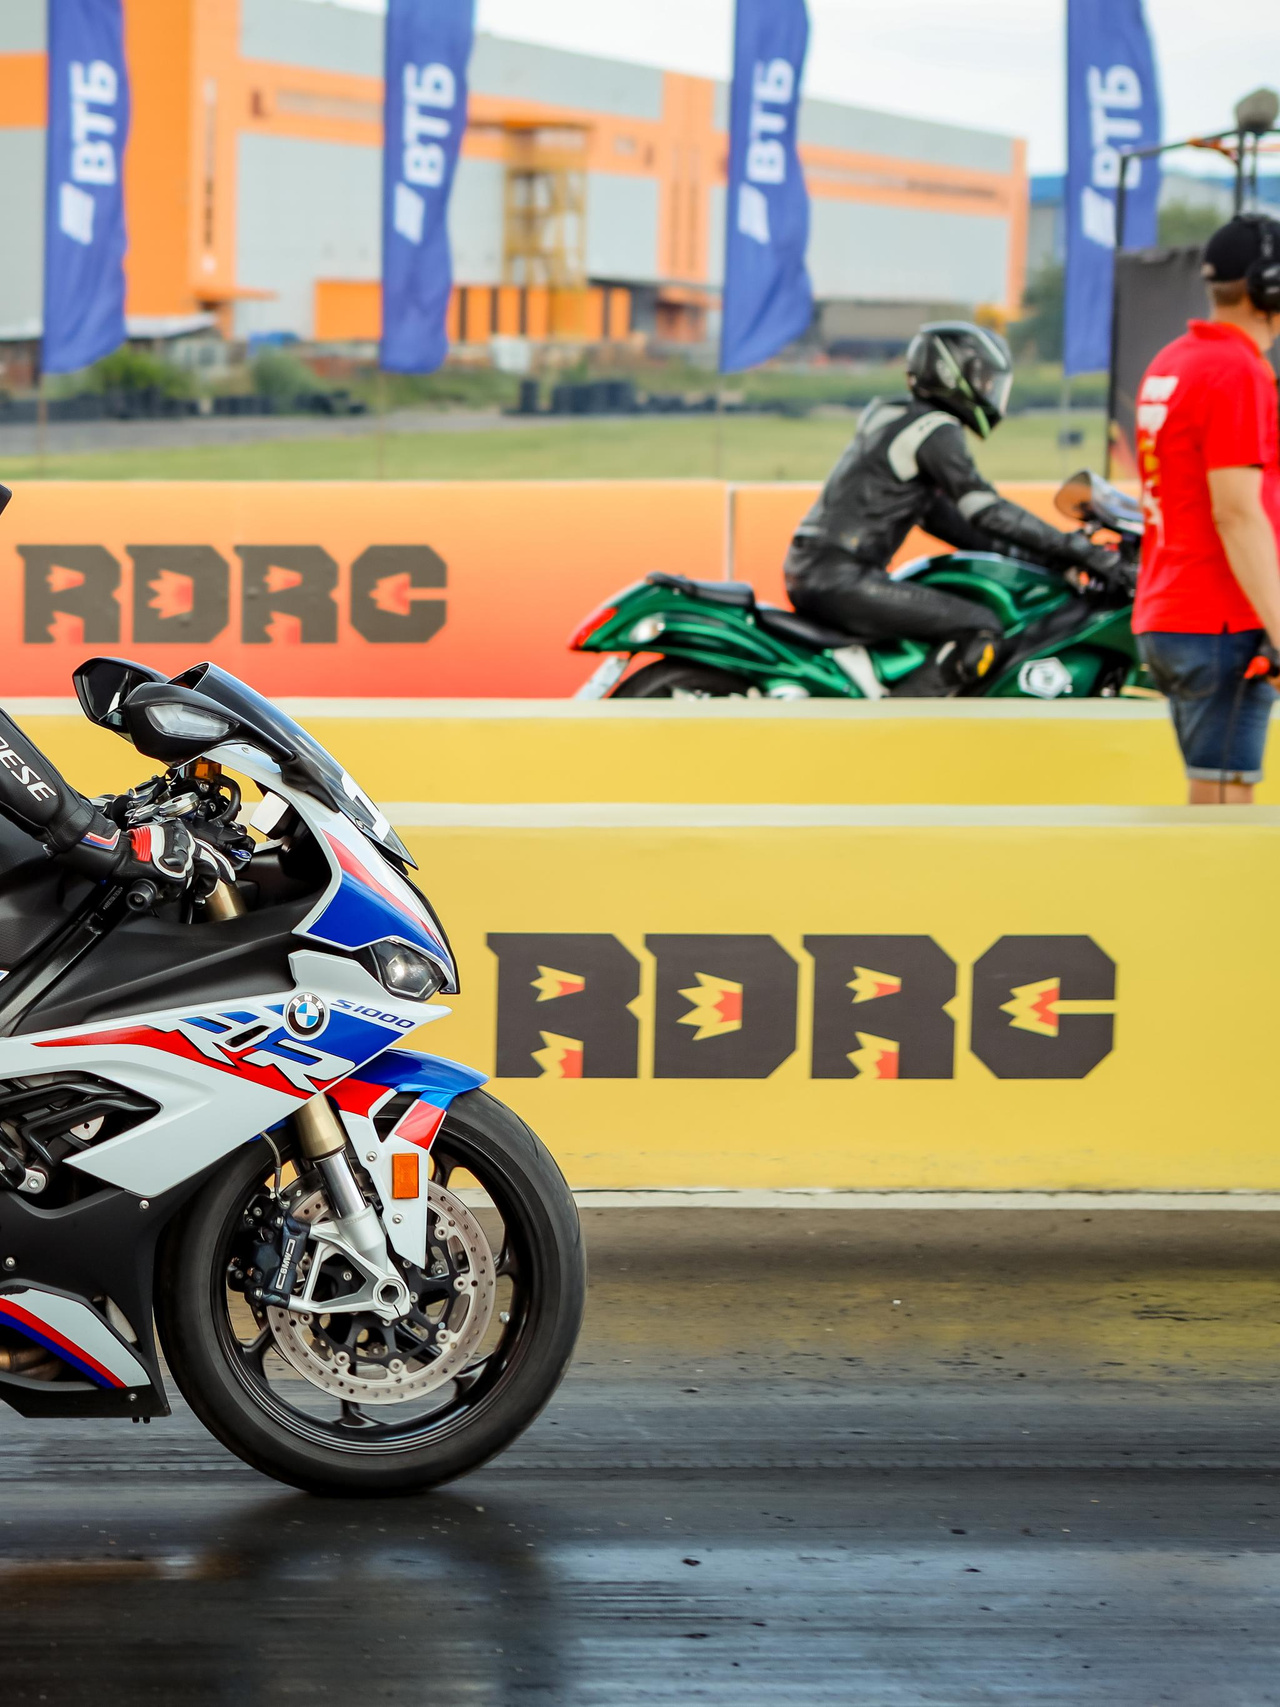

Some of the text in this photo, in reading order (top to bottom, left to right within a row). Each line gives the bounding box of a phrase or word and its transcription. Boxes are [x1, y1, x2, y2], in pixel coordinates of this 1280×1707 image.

[16, 544, 447, 644] RDRC
[485, 932, 1117, 1079] RDRC
[280, 1251, 291, 1274] BMW
